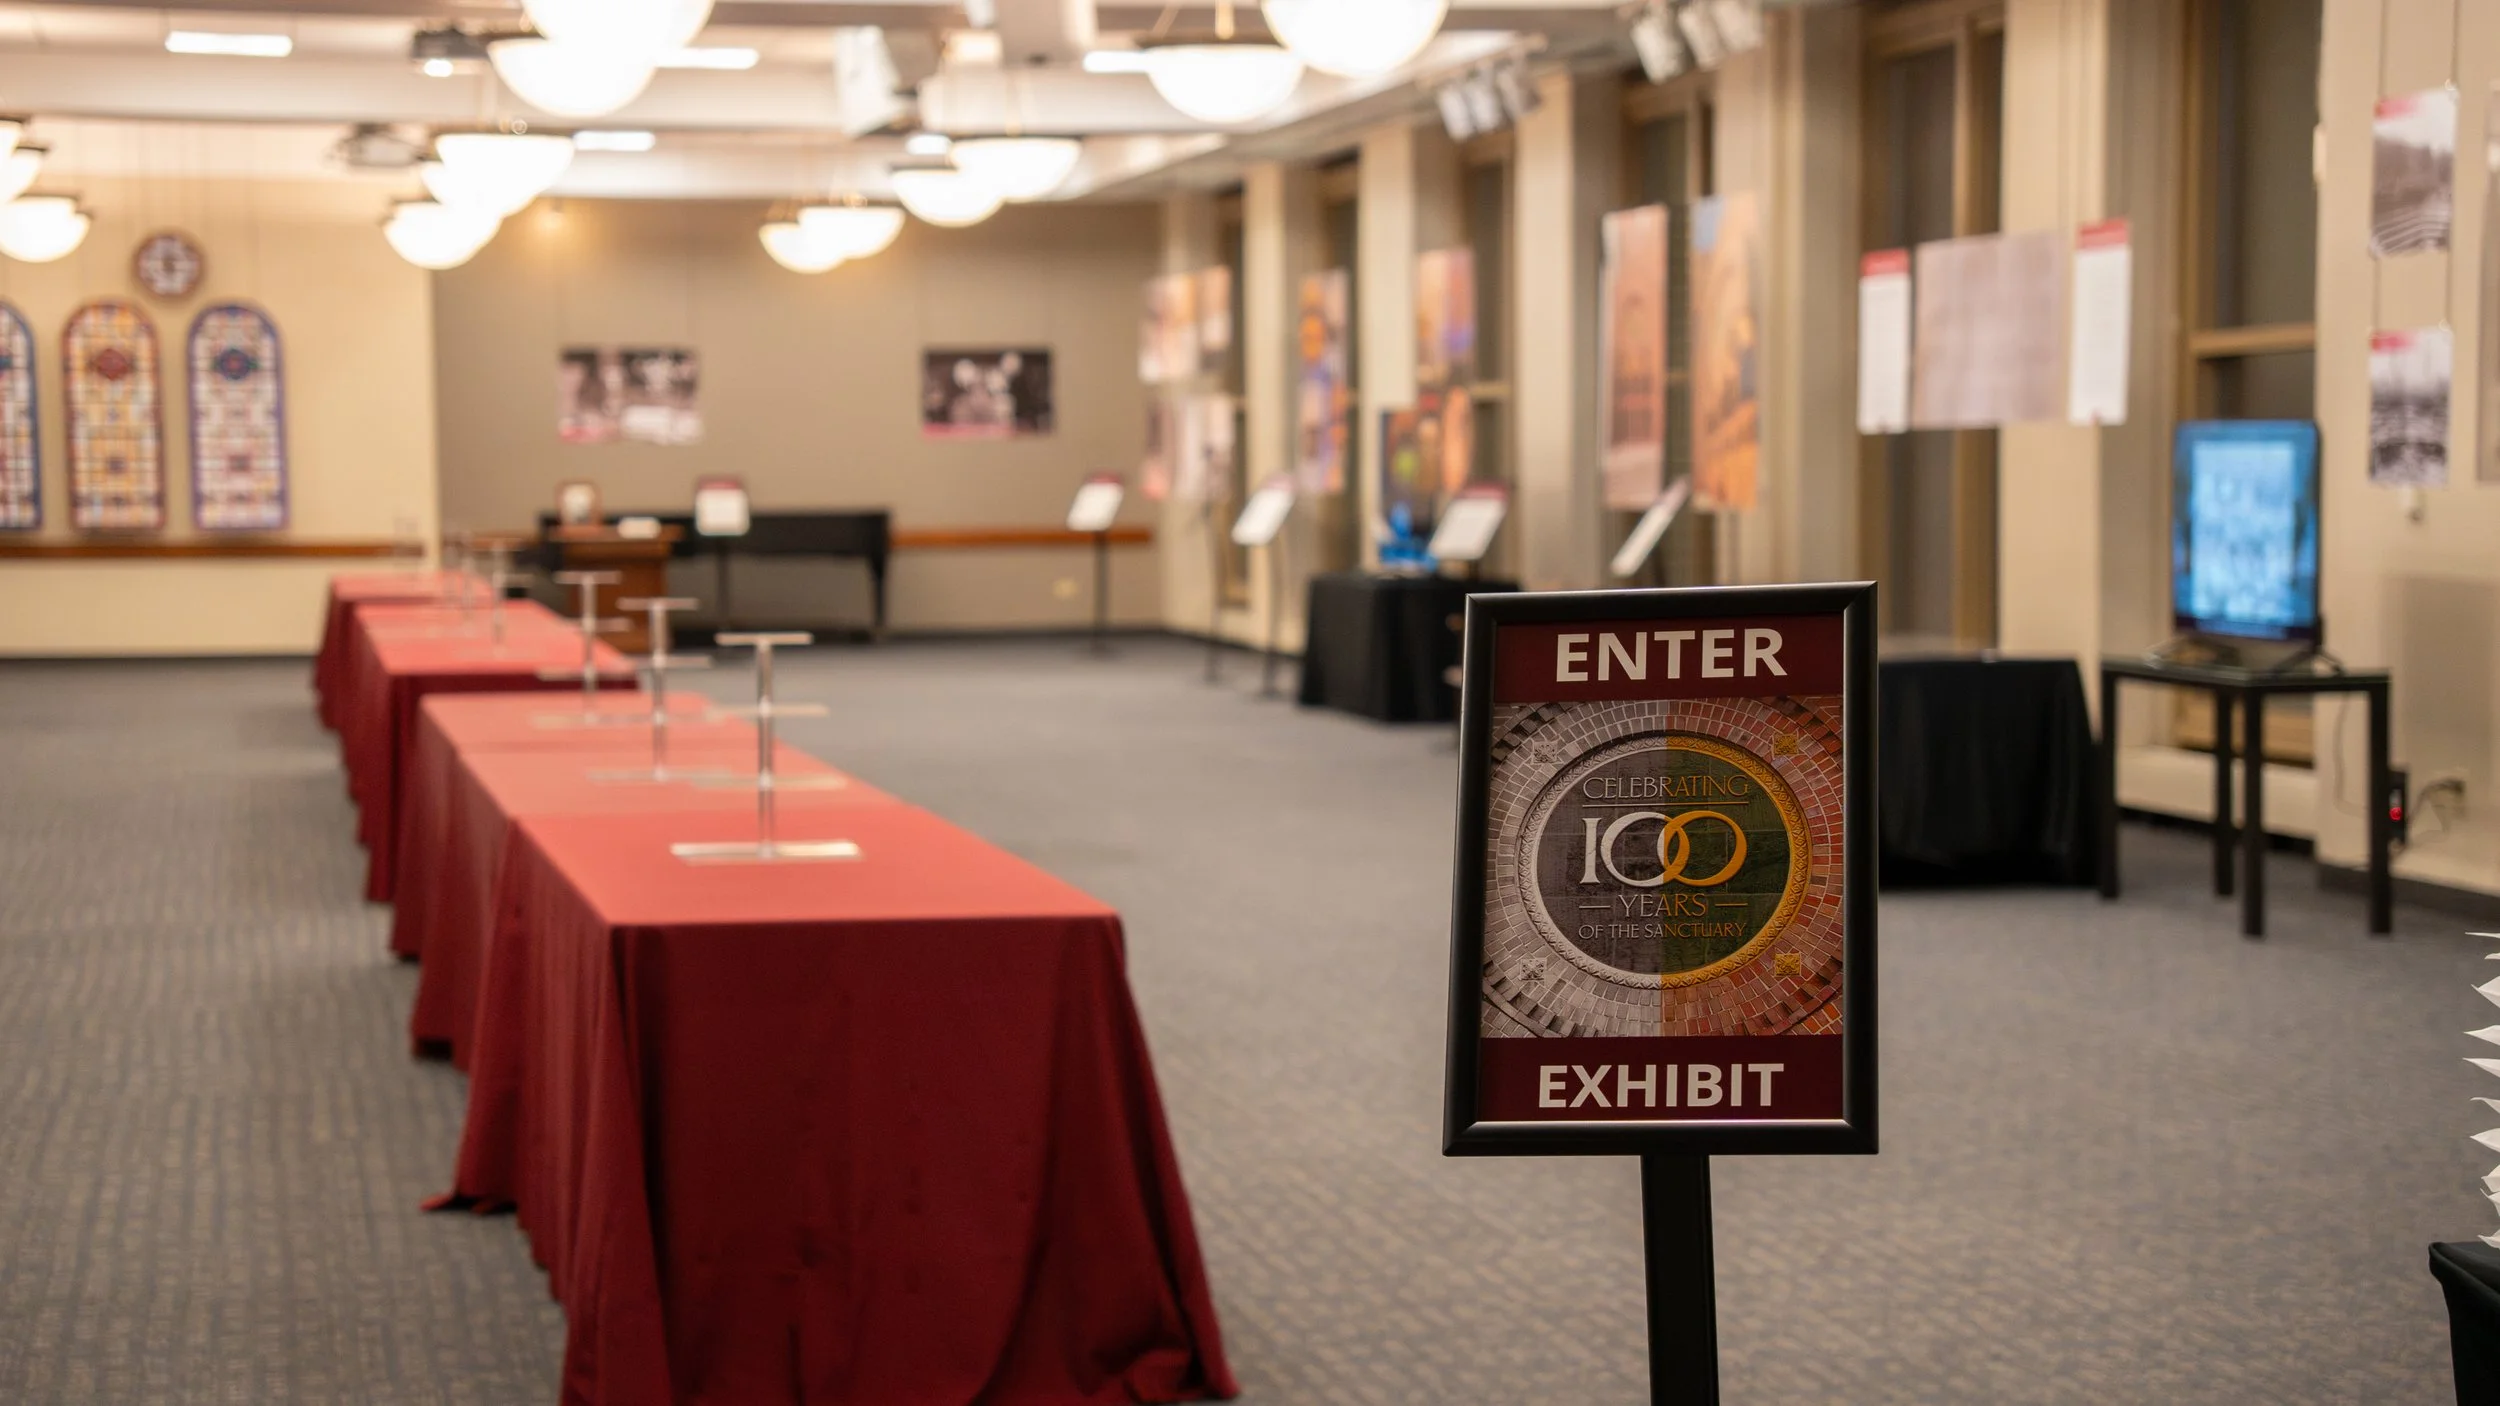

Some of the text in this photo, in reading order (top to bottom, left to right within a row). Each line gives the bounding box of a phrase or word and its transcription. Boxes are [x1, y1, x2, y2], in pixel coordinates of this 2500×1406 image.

[1556, 628, 1788, 682] ENTER
[1583, 775, 1748, 799] CELEBRATING
[1579, 810, 1748, 887] 100
[1618, 893, 1707, 918] YEARS
[1578, 922, 1747, 940] OF THE SANCTUARY
[1538, 1062, 1784, 1109] EXHIBIT
